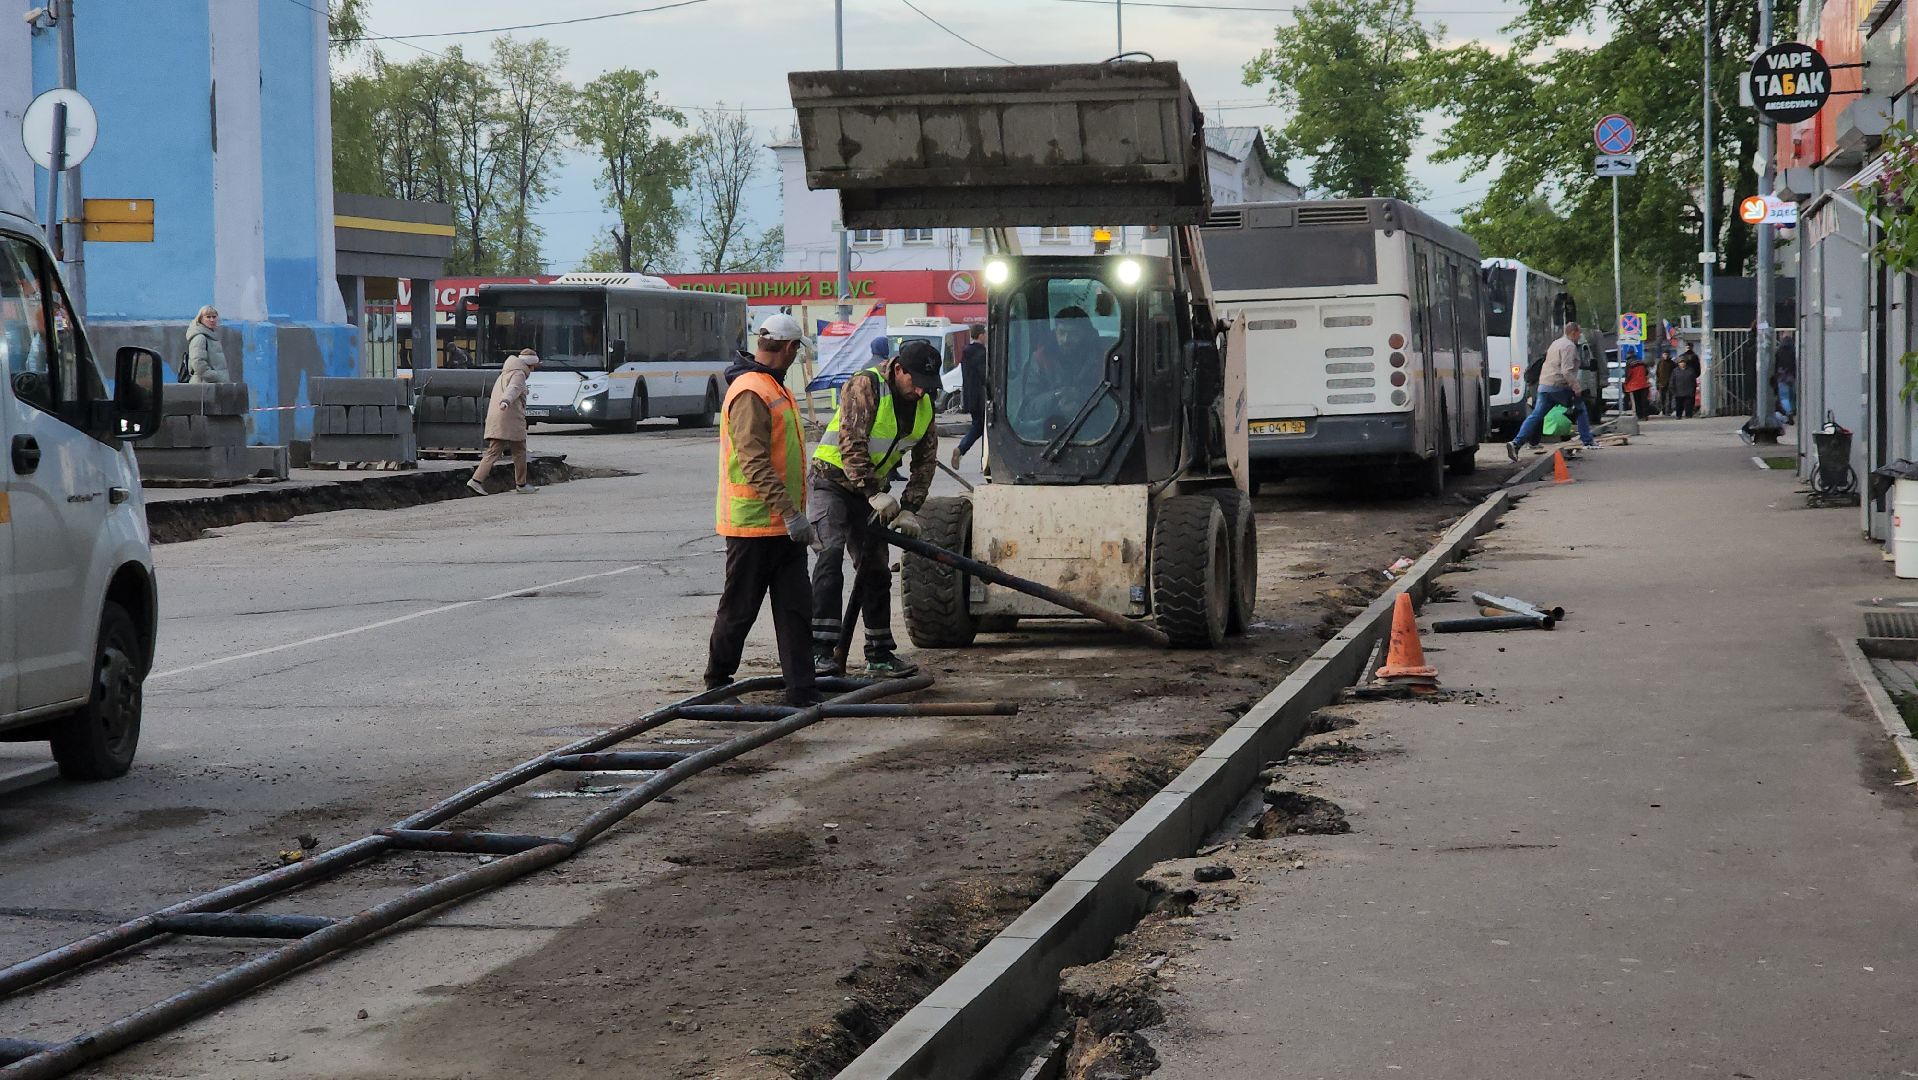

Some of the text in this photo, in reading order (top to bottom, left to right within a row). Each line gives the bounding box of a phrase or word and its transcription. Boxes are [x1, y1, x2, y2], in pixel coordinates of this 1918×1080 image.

[1766, 52, 1812, 70] VAPE
[1755, 72, 1825, 97] ТАБАК
[1765, 99, 1818, 111] АКСЕССУАРЫ
[1770, 208, 1797, 218] ЗДЕС
[1269, 422, 1288, 433] 041
